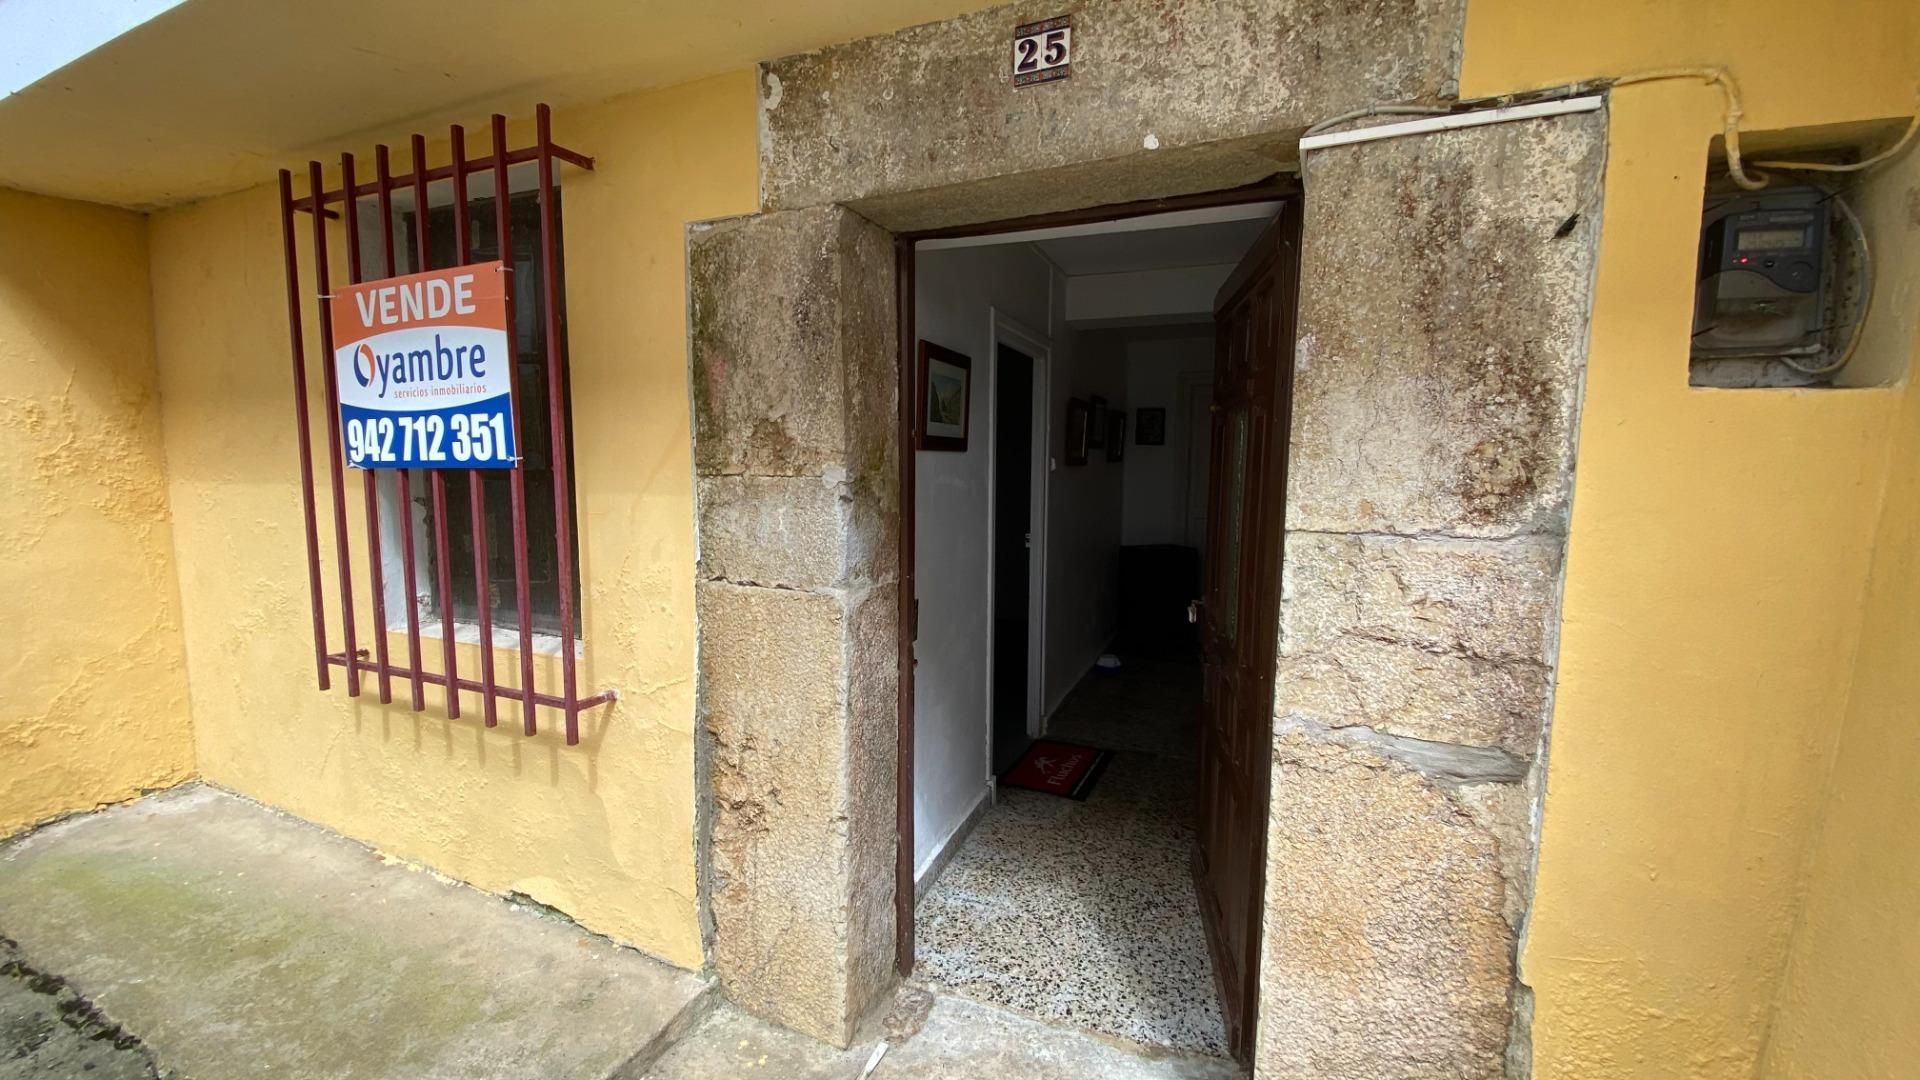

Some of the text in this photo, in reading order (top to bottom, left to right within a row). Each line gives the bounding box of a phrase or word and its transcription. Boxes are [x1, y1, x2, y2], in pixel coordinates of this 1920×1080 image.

[1018, 31, 1066, 72] 25
[355, 274, 476, 327] VENDE
[353, 334, 486, 398] Oyambre
[394, 384, 487, 399] servicios inmobiliarios
[348, 412, 507, 462] 942 712 351
